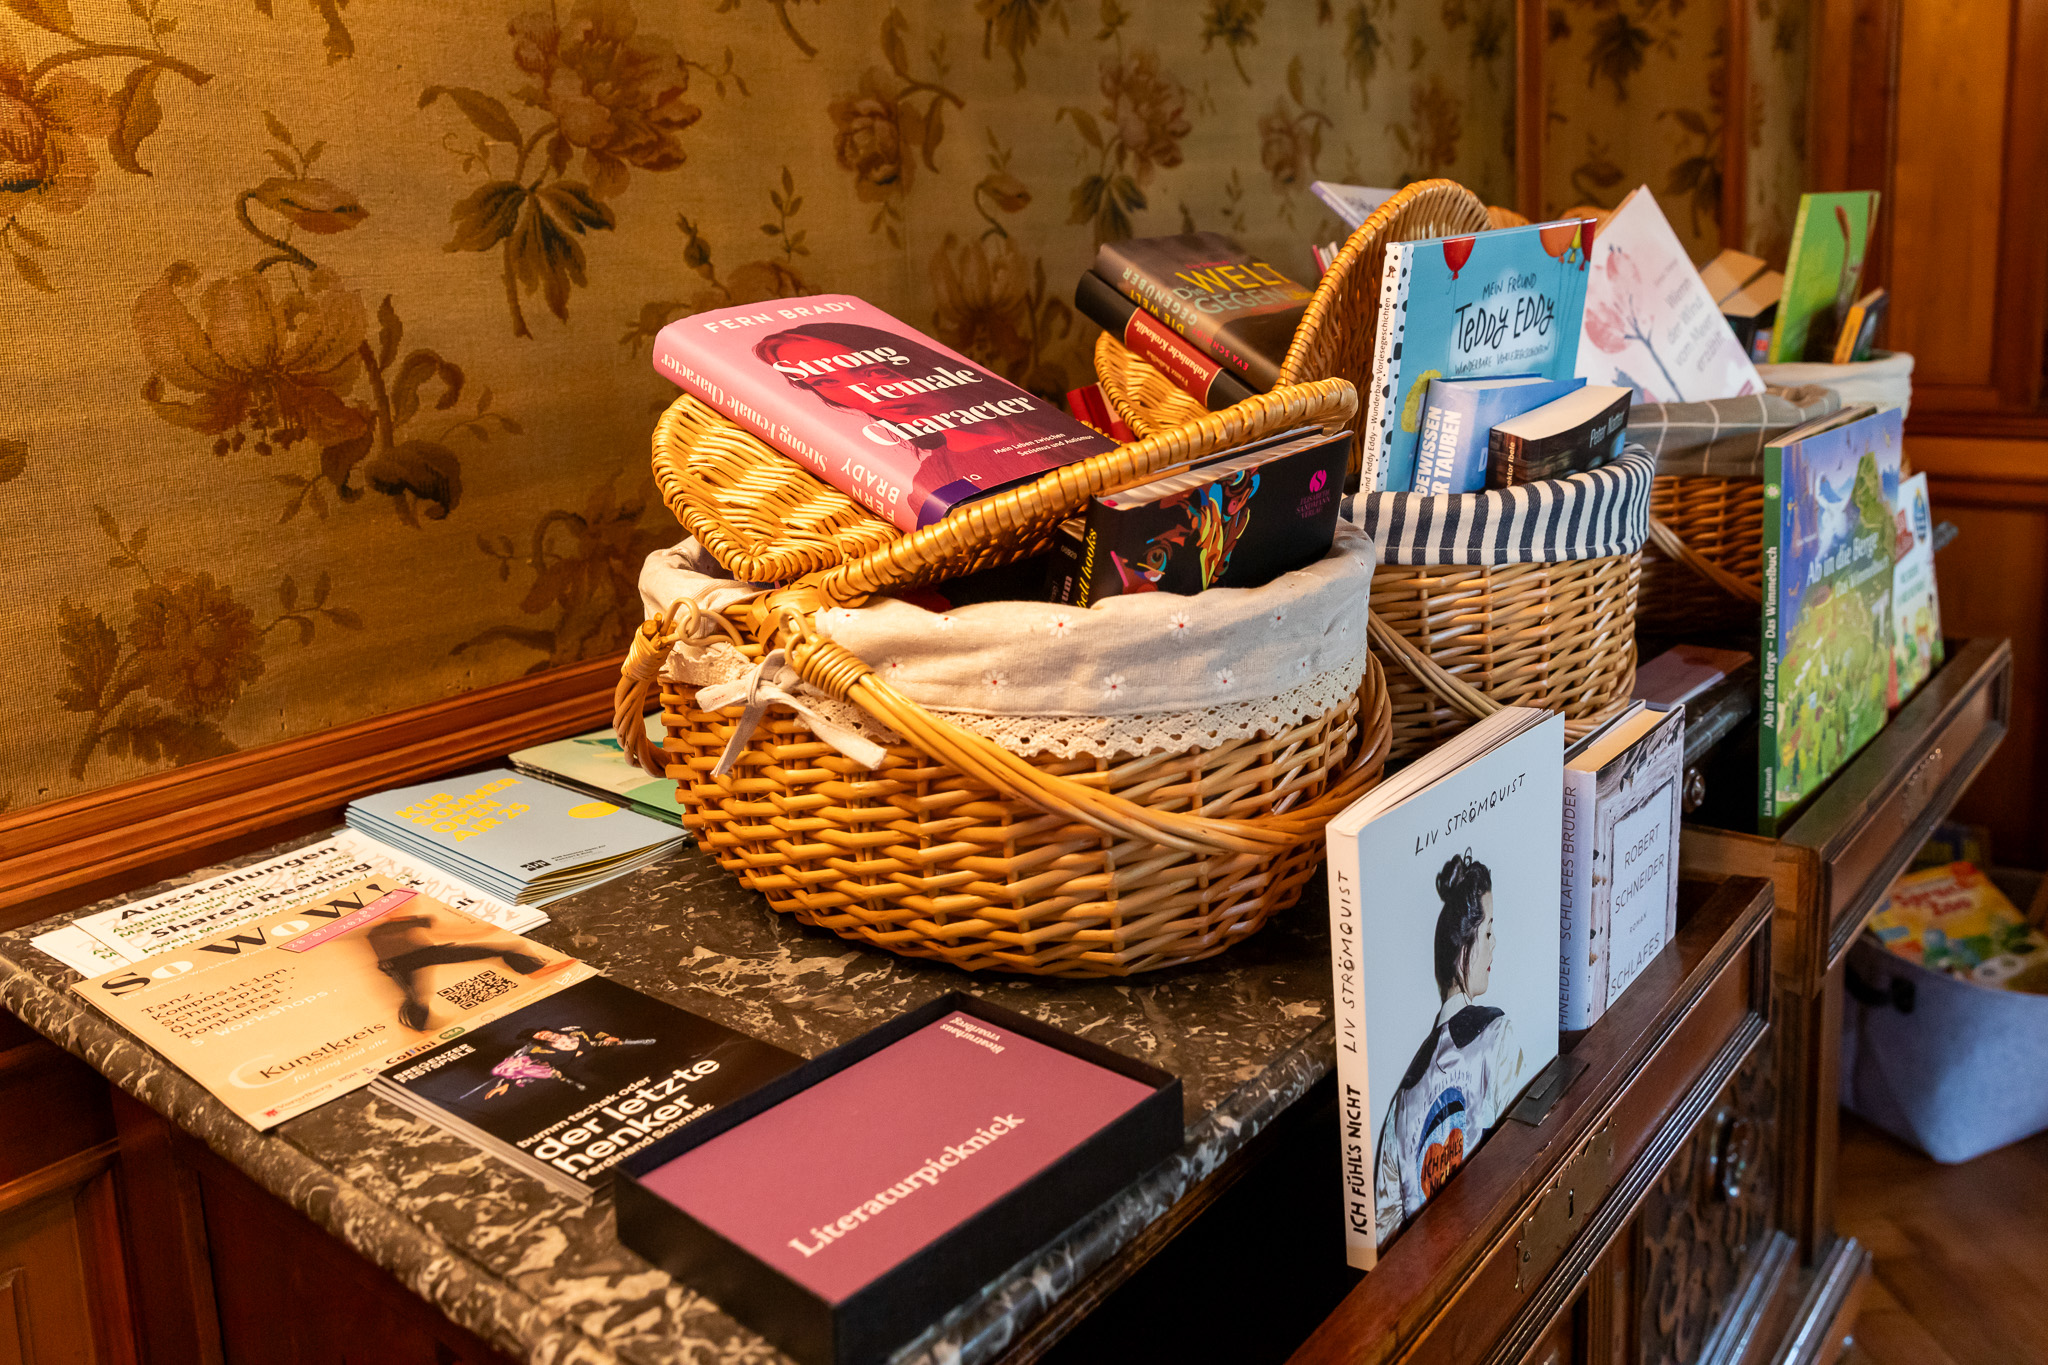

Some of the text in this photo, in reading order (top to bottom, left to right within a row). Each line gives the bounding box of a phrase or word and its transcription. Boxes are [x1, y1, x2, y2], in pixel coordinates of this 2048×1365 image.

[1122, 267, 1198, 326] GEGENÜBER
[1172, 285, 1207, 300] Die
[1174, 261, 1293, 294] WELT
[1482, 280, 1504, 300] MEIN
[703, 300, 857, 335] FERN BRADY
[1130, 289, 1185, 335] DIE WELT
[1133, 319, 1210, 381] Kubanische Krokodile
[1191, 327, 1250, 371] EVA SCHMIDT
[1376, 297, 1391, 381] Vorlesegeschichten
[772, 346, 911, 382] Strong
[848, 364, 984, 403] Female
[660, 352, 829, 473] Strong Female Character
[862, 393, 1038, 447] Character
[1371, 379, 1382, 426] Wunderbare
[993, 433, 1066, 455] Mein Leben zwischen
[1017, 435, 1095, 457] Sexismus und Autismus
[1367, 431, 1378, 451] Eddy
[1413, 405, 1443, 497] GEWISSEN
[1433, 409, 1462, 478] TAUBEN
[1588, 424, 1607, 449] Peter
[840, 457, 901, 505] BRADY
[1364, 452, 1376, 475] Teddy
[851, 484, 896, 523] FERN
[1081, 527, 1098, 580] hooks
[1805, 559, 1824, 587] Ab
[1765, 546, 1778, 618] Wimmelbuch
[1764, 618, 1777, 641] Das
[1763, 652, 1778, 682] Berge
[1763, 682, 1775, 700] die
[1764, 699, 1775, 712] in
[1763, 713, 1775, 729] Ab
[394, 792, 454, 819] KUB
[411, 777, 523, 827] SOMMER
[430, 799, 503, 833] OPEN
[452, 801, 531, 843] AIR 25
[1414, 772, 1526, 857] LIV STRÖMQUIST
[1563, 786, 1577, 854] BRUDER
[1624, 823, 1661, 870] ROBERT
[121, 846, 338, 920] Ausstellungen
[150, 900, 254, 938] Shared
[257, 862, 373, 902] Reading
[1560, 858, 1574, 942] SCHLAFES
[1614, 852, 1665, 914] SCHNEIDER
[1629, 912, 1648, 934] ROMAN
[1337, 871, 1358, 1053] LIV STRÖMQUIST
[1610, 931, 1660, 998] SCHLAFES
[150, 966, 296, 1021] Komposition.
[160, 976, 295, 1027] Schauspiel.
[179, 996, 292, 1040] Tonkunst.
[259, 1022, 386, 1079] Kunstkreis
[292, 1038, 389, 1085] für jung und alle
[385, 1040, 437, 1065] Collini
[392, 1043, 469, 1080] BREGENZER
[399, 1046, 477, 1084] FESTSPIELE
[516, 1076, 651, 1149] bumm tschak oder
[533, 1059, 720, 1160] der letzte
[1345, 1083, 1362, 1139] NICHT
[551, 1094, 695, 1175] henker
[576, 1102, 715, 1181] Ferdinand Schmalz
[788, 1110, 1026, 1259] Literaturpicknick
[1351, 1199, 1369, 1237] ICH
